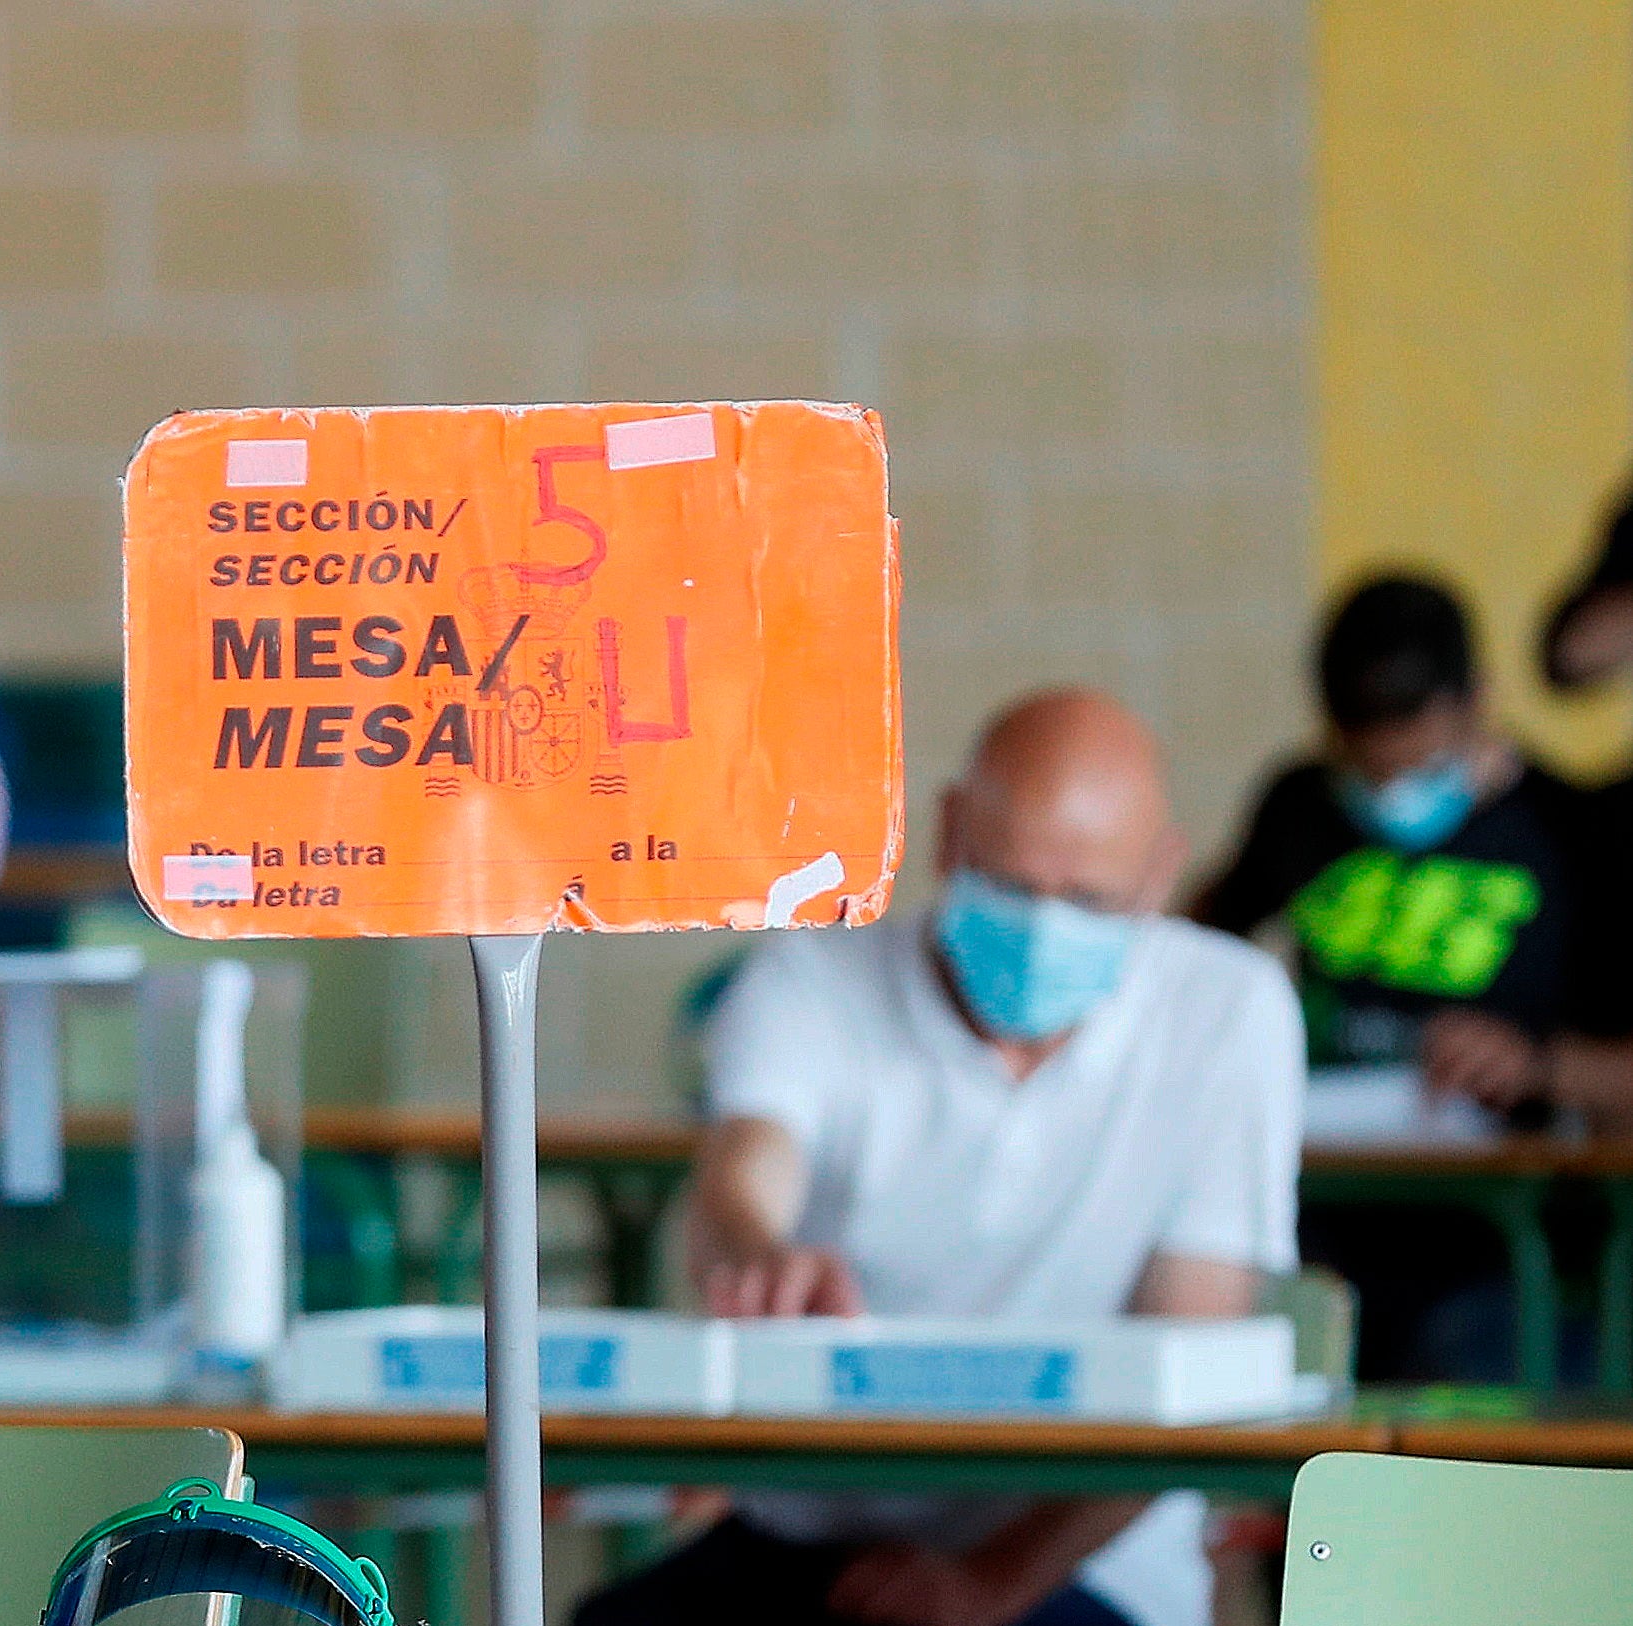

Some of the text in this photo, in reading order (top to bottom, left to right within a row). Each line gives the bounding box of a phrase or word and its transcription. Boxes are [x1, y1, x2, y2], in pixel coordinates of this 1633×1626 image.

[208, 491, 468, 537] SECCIÓN/
[507, 445, 608, 587] 5
[209, 544, 440, 586] SECCIÓN
[212, 614, 530, 691] MESA/
[597, 615, 693, 749] U
[213, 703, 475, 769] MESA
[251, 841, 284, 867] la
[299, 840, 387, 867] letra
[610, 840, 633, 862] a
[647, 834, 678, 861] la
[252, 881, 342, 908] letra
